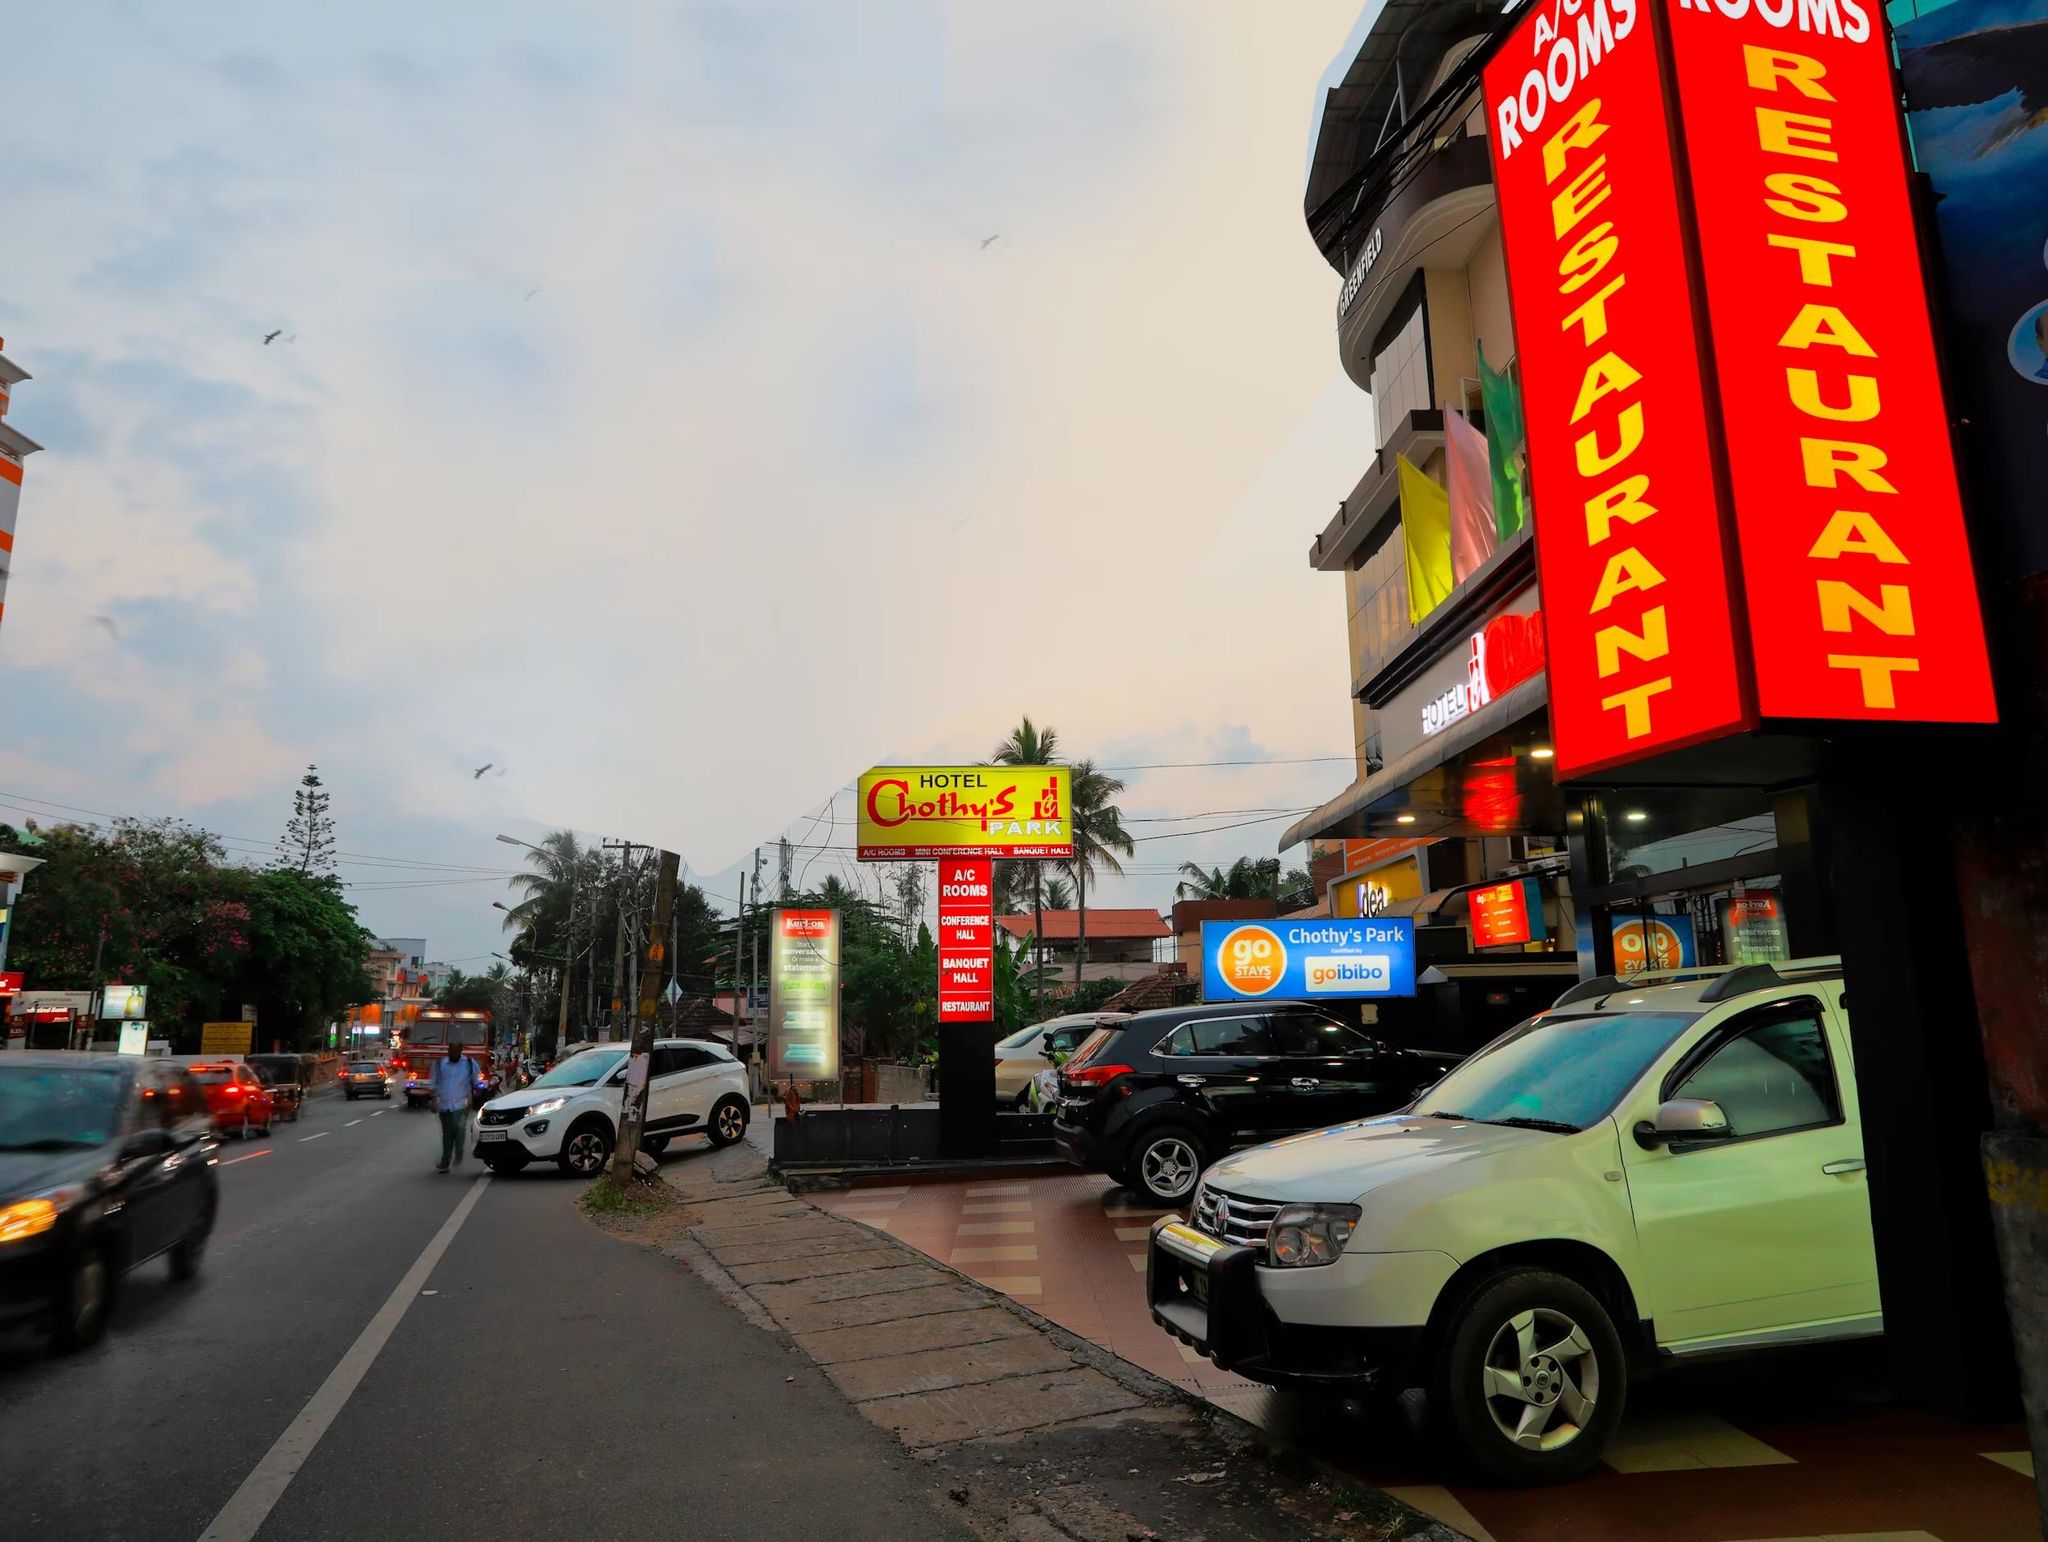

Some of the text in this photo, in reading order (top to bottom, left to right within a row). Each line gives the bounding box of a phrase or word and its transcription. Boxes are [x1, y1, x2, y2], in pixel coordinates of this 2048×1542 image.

[1497, 0, 1637, 160] ROOMS
[1340, 228, 1382, 316] GREENFIELD
[1742, 43, 1920, 709] RESTAURANT
[1542, 97, 1672, 739] RESTAURANT
[920, 775, 987, 788] HOTEL
[988, 821, 1063, 836] PARK
[863, 848, 876, 856] A/C
[878, 848, 906, 856] ROOMS
[915, 848, 932, 856] MINI
[932, 848, 983, 856] CONFERENCE
[1013, 847, 1048, 855] BANQUET
[1051, 847, 1070, 855] HALL
[954, 869, 976, 882] A/C
[943, 884, 988, 897] ROOMS
[786, 918, 824, 930] Kurl-on
[941, 916, 989, 926] CONFERENCE
[956, 930, 975, 940] HALL
[1288, 926, 1404, 946] Chothy's Park
[1233, 938, 1271, 965] go
[943, 958, 989, 969] BANQUET
[953, 972, 978, 983] HALL
[1235, 965, 1272, 977] STAYS
[1312, 963, 1382, 984] goibibo
[942, 1002, 990, 1012] RESTAURANT
